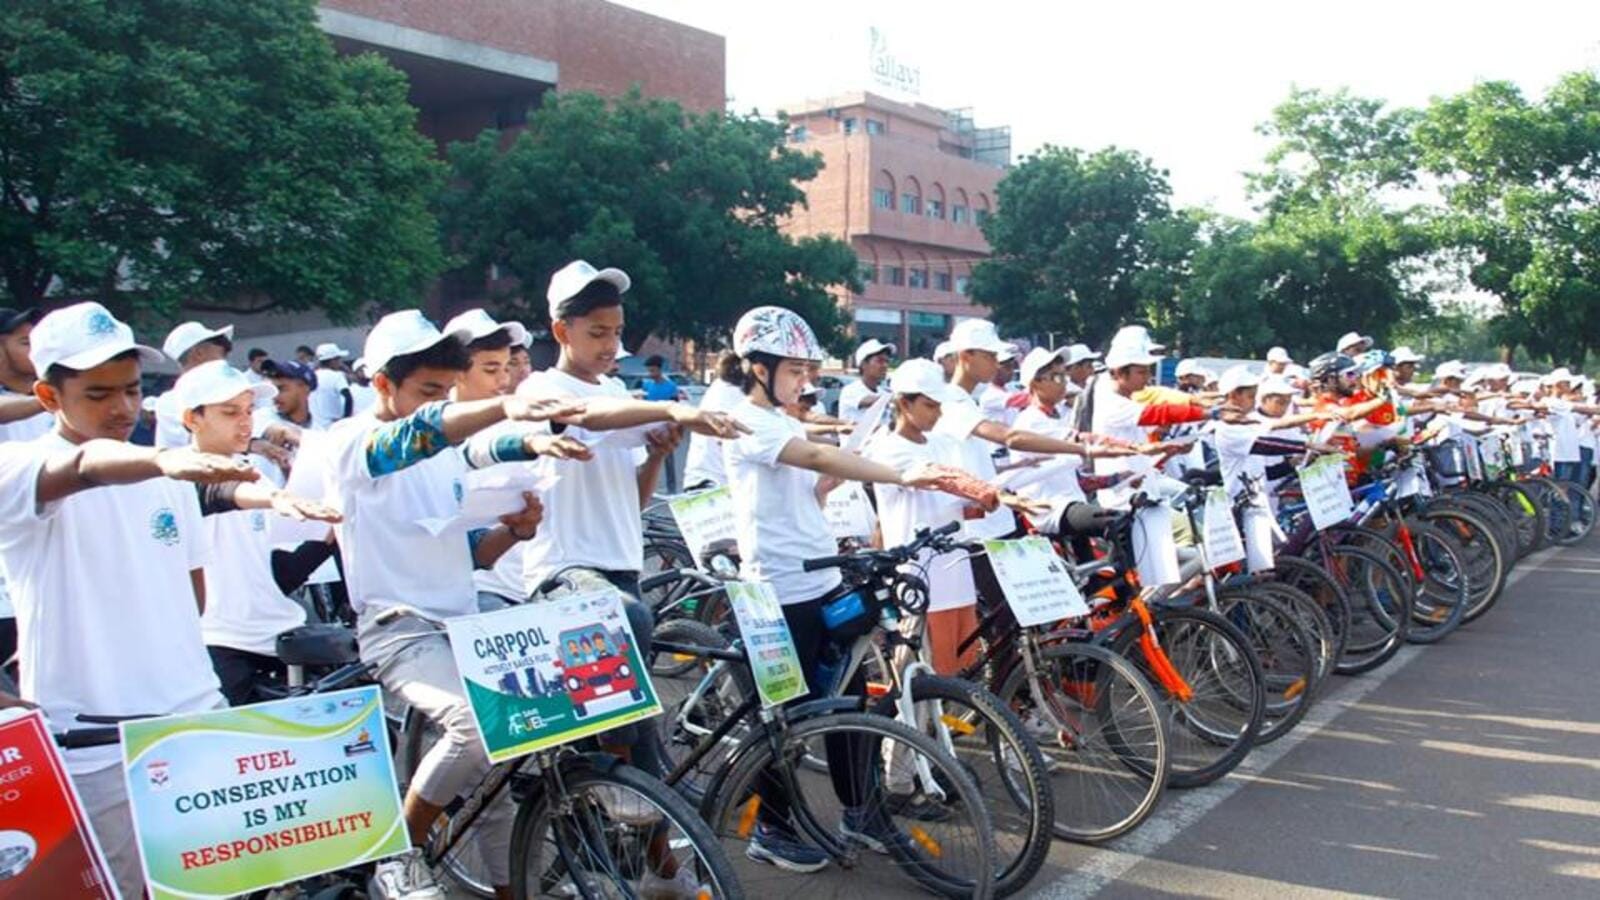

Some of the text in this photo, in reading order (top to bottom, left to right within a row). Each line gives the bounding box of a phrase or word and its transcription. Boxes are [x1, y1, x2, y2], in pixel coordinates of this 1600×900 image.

[474, 627, 550, 659] CARPOOL
[235, 750, 296, 775] FUEL
[175, 763, 358, 814] CONSERVATION
[243, 799, 308, 828] IS MY
[180, 811, 373, 870] RESPONSIBILITY
